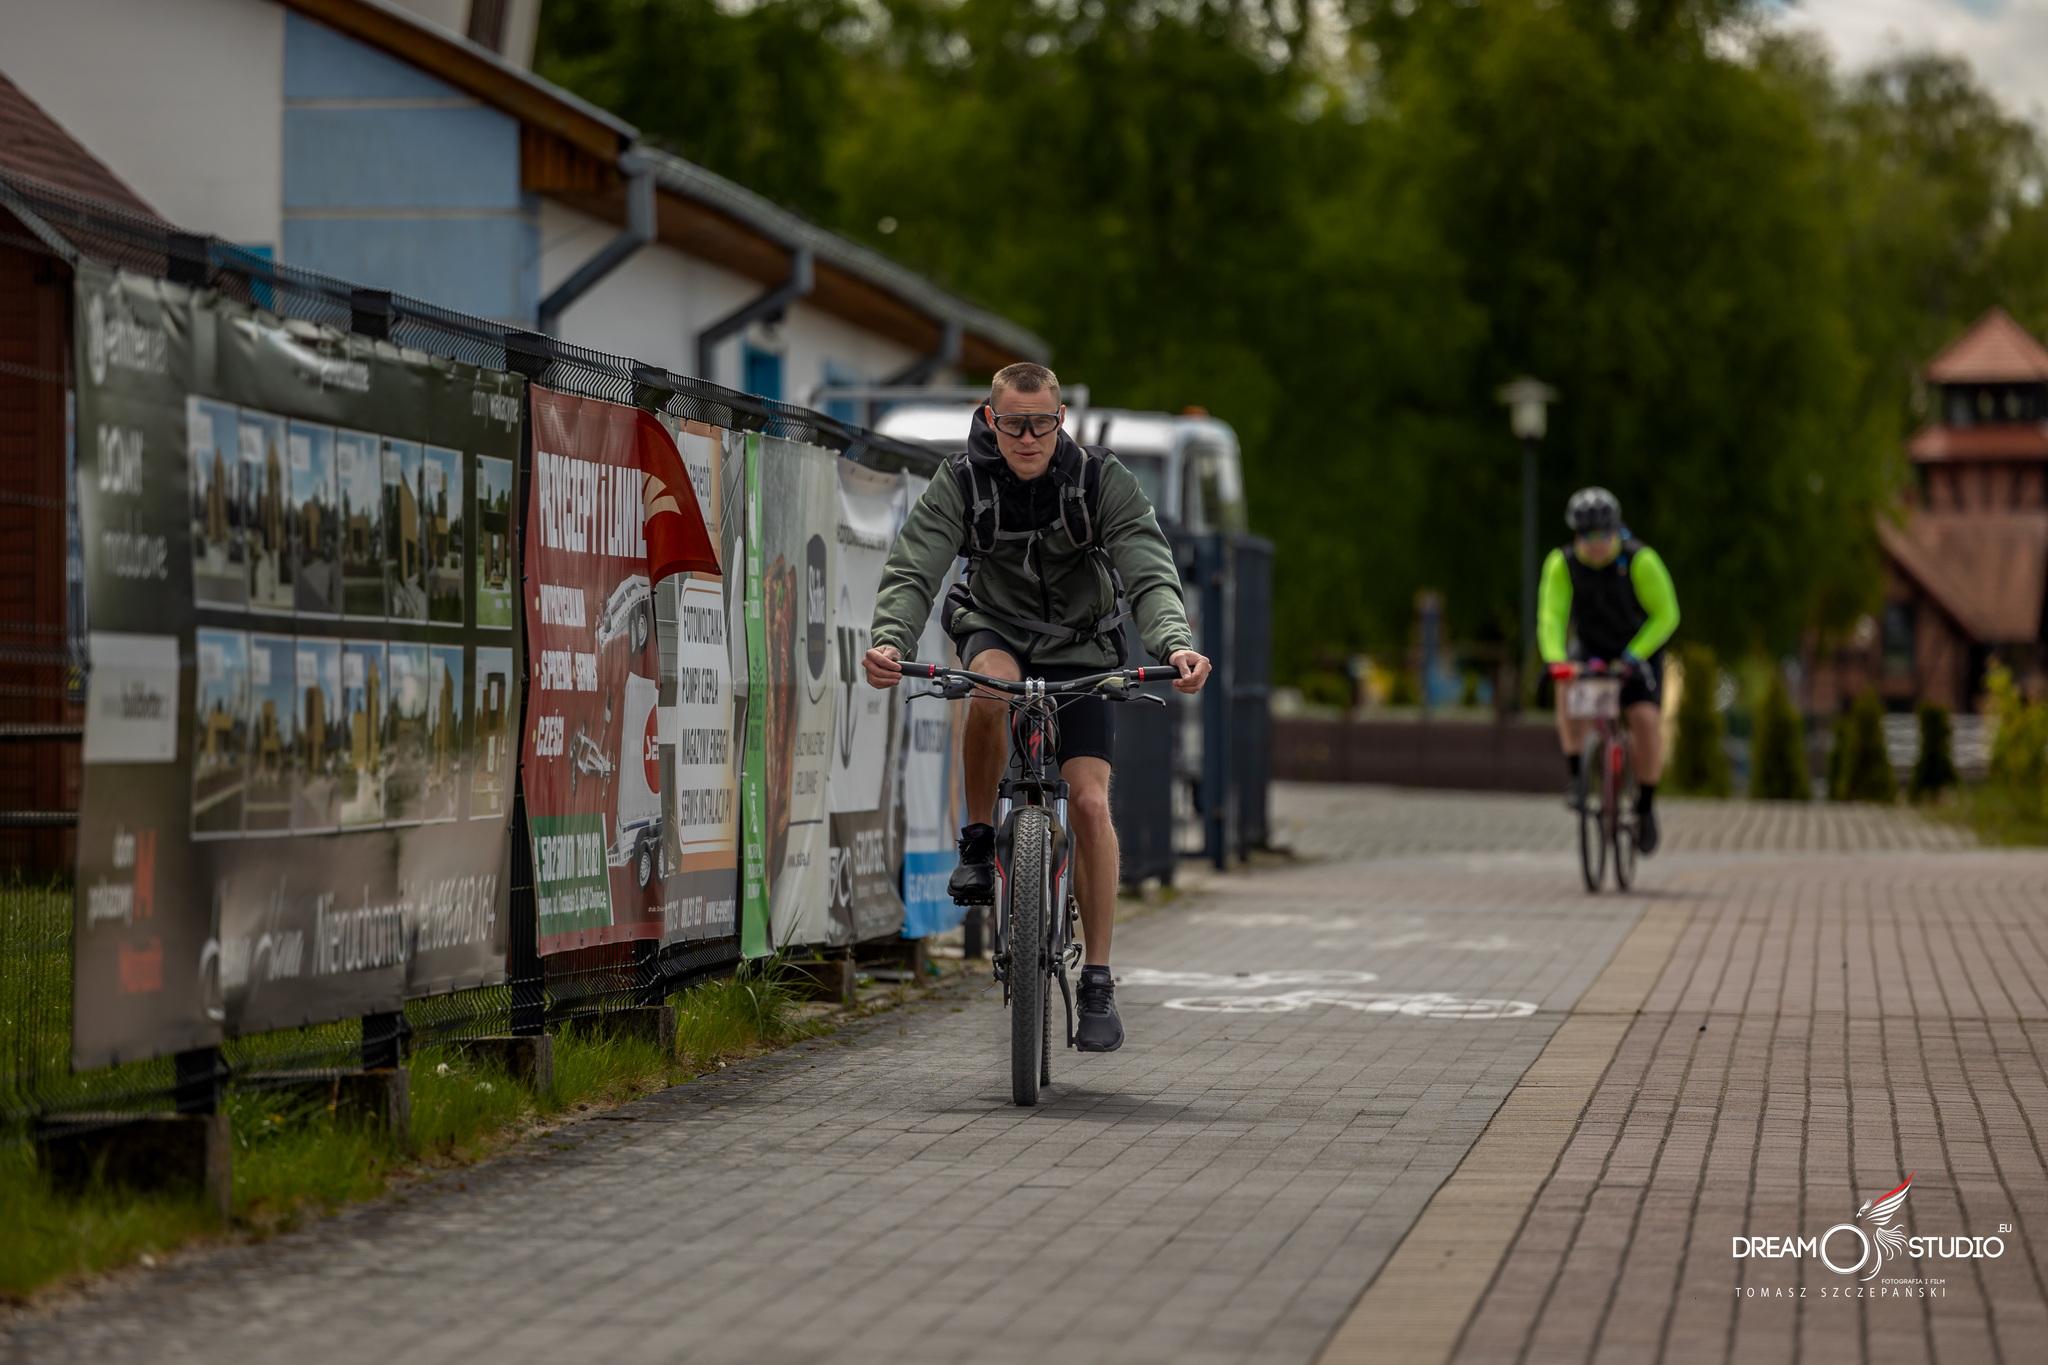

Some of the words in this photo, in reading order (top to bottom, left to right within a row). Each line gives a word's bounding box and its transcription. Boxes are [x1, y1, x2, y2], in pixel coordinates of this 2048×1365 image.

[538, 451, 599, 554] PRZYCZEPY
[608, 465, 648, 559] LAWE
[683, 605, 723, 646] FOTOWOLTAIKA
[682, 666, 701, 704] POMPY
[536, 709, 565, 763] CZĘŚCI
[681, 728, 710, 765] MAGAZYNY
[476, 874, 496, 941] 164
